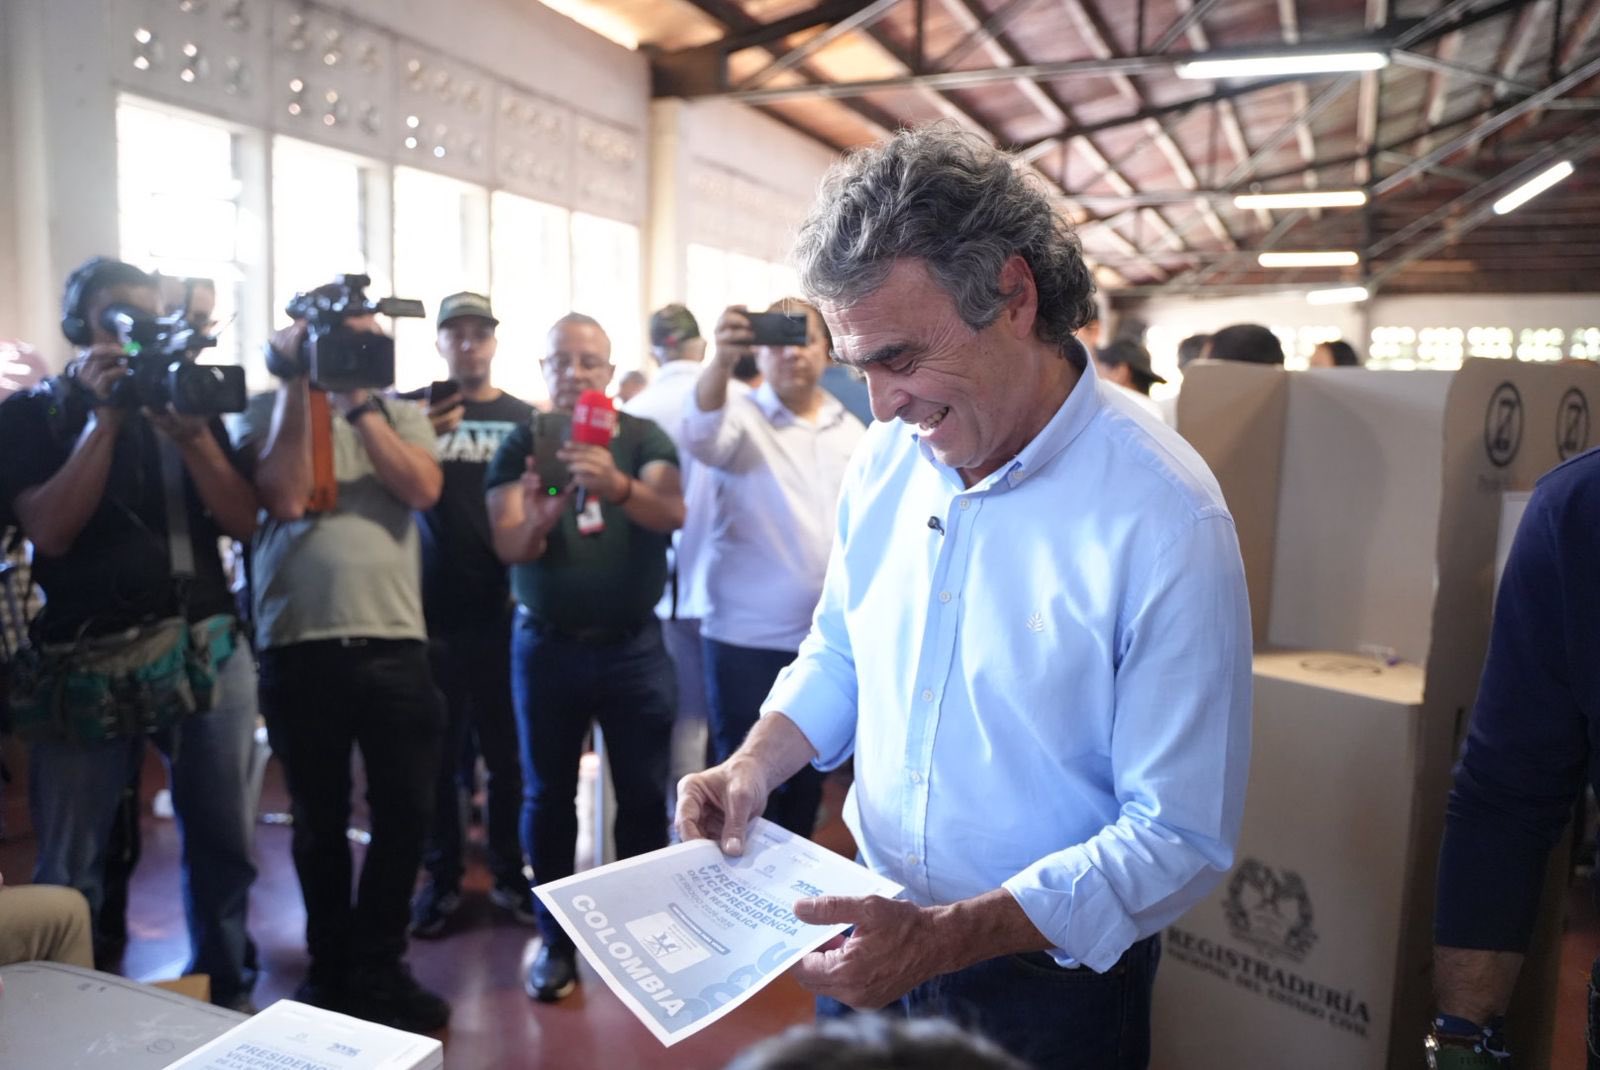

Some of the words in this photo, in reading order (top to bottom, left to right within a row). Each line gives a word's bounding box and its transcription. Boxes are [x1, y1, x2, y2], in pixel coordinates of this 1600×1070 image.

[698, 884, 711, 896] LA
[698, 867, 798, 936] VICEPRESIDENCIA
[707, 864, 799, 924] PRESIDENCIA
[572, 894, 686, 1017] COLOMBIA
